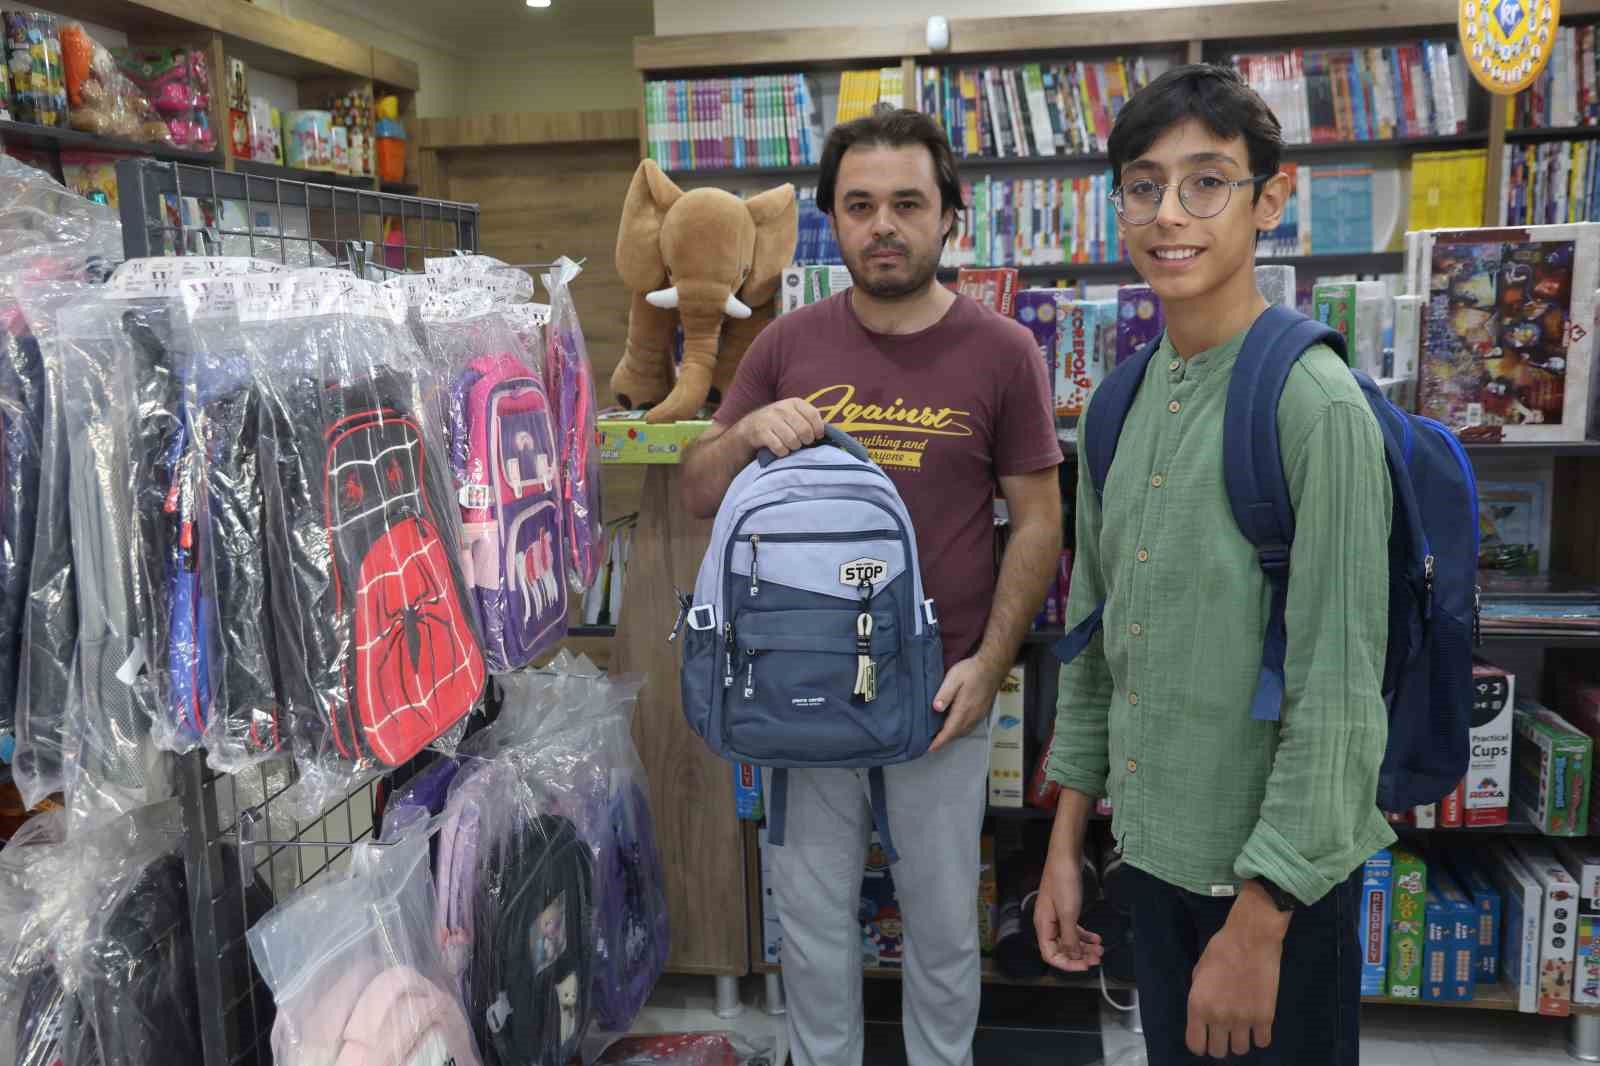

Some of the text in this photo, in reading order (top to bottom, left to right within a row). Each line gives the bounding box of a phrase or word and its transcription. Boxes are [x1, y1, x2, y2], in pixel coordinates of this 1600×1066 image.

[806, 384, 970, 433] Against
[903, 439, 929, 450] and
[845, 566, 883, 581] STOP
[1472, 733, 1509, 742] Practical
[1472, 745, 1508, 759] Cups
